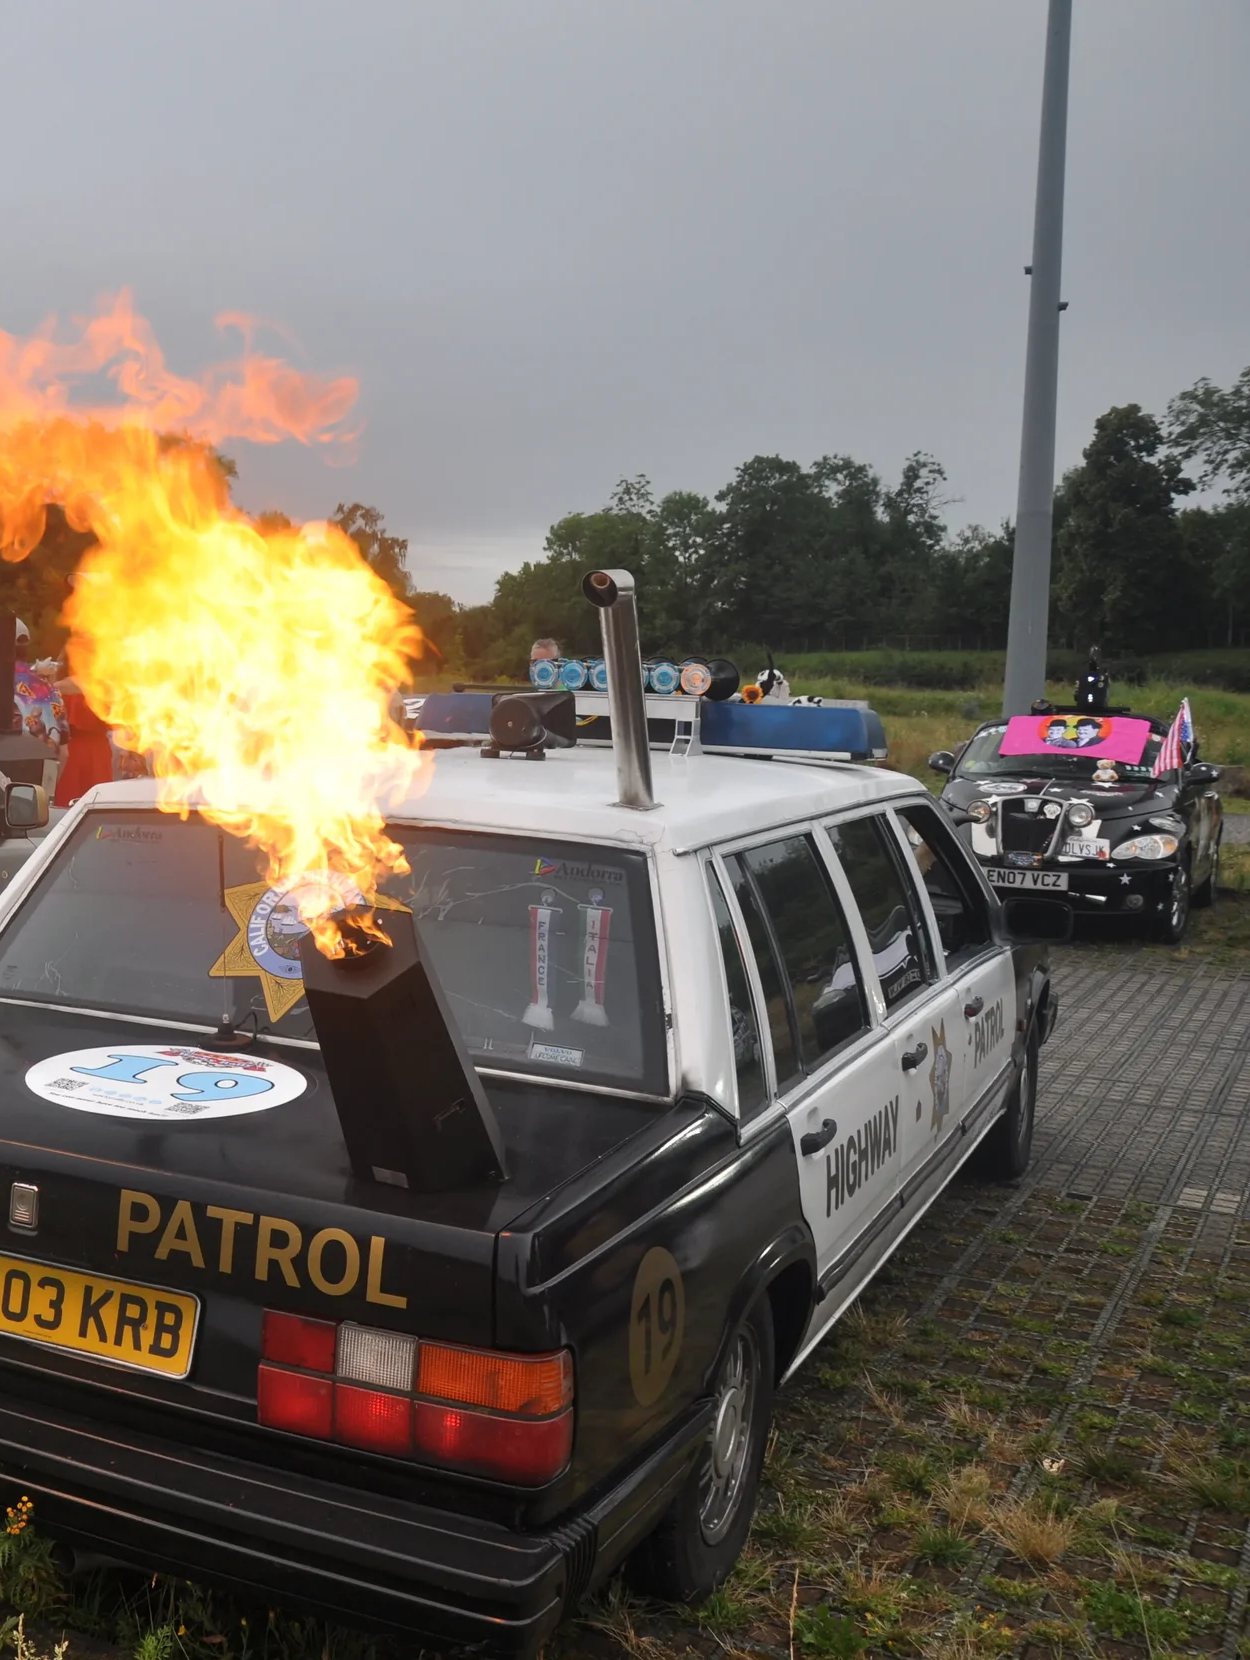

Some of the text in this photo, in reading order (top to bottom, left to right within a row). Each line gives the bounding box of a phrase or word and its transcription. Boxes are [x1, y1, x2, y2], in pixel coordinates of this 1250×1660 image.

[555, 861, 624, 882] Andorra
[986, 869, 1062, 887] EN07 VCZ
[537, 921, 547, 986] FRANCE
[584, 920, 598, 990] ITALIA
[974, 998, 1004, 1069] PATROL
[70, 1054, 275, 1102] 19
[826, 1095, 899, 1218] HIGHWAY
[116, 1189, 407, 1309] PATROL
[78, 1284, 183, 1359] KRB
[637, 1278, 677, 1376] 19
